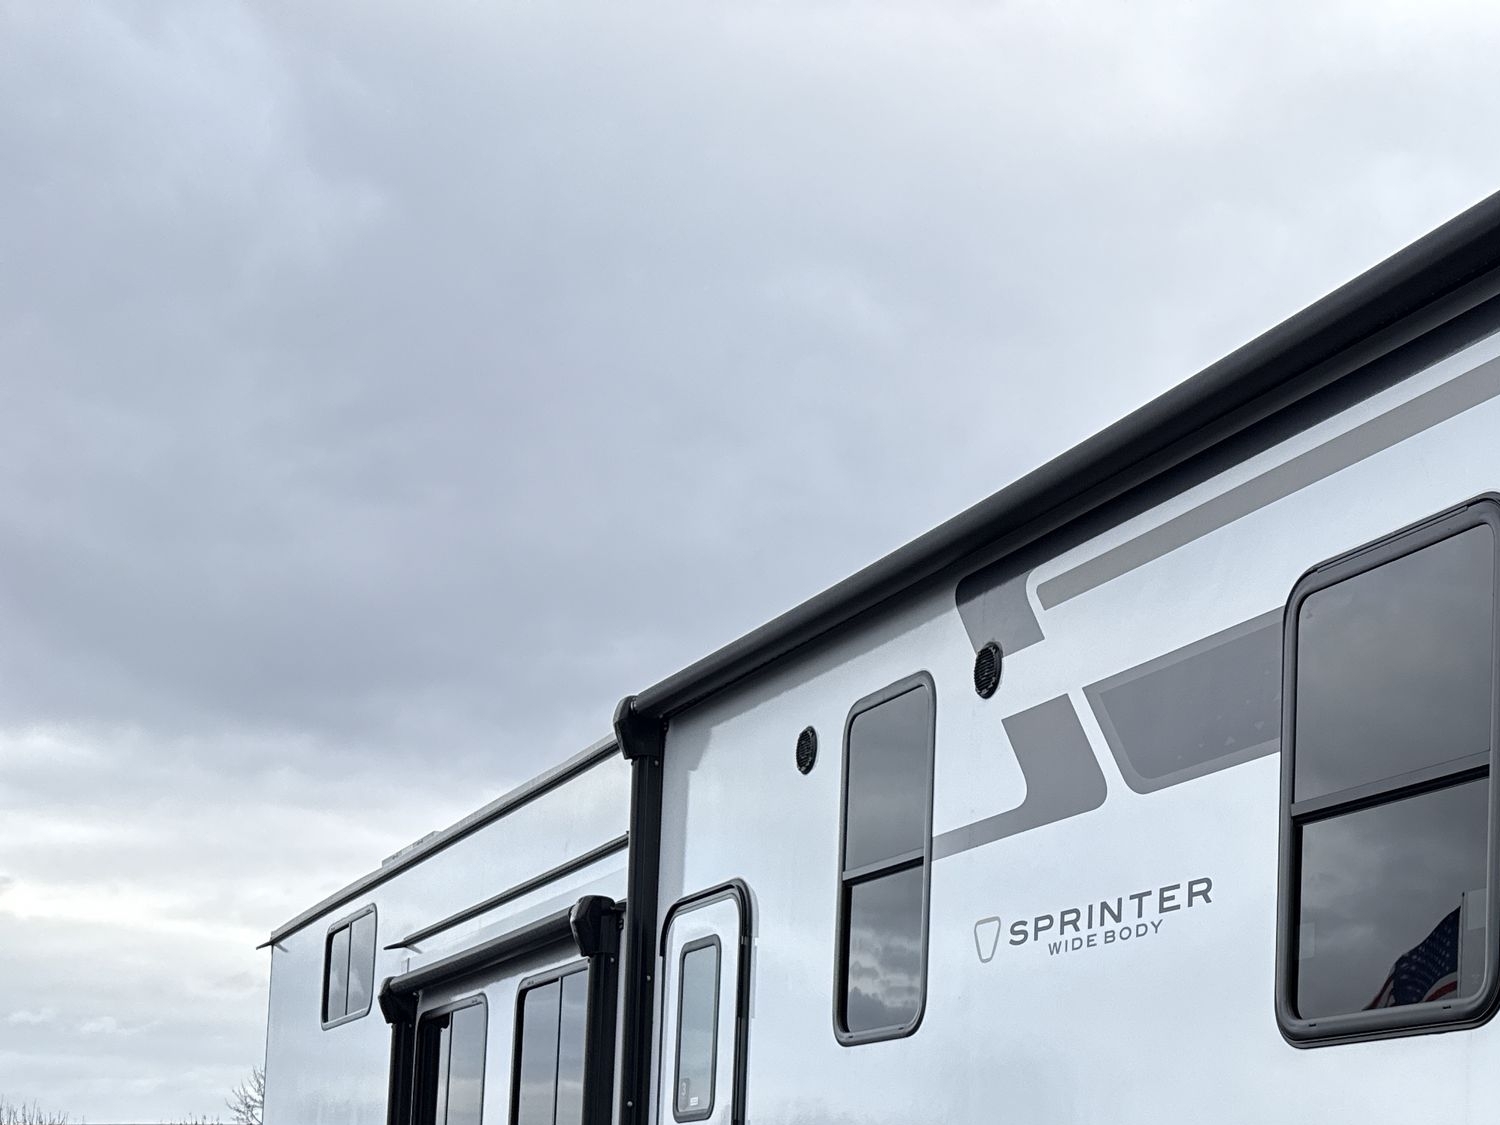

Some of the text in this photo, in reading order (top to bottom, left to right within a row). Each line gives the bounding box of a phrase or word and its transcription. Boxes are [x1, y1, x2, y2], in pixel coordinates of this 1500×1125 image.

[1009, 877, 1213, 946] SPRINTER
[1048, 919, 1164, 956] WIDE BODY
